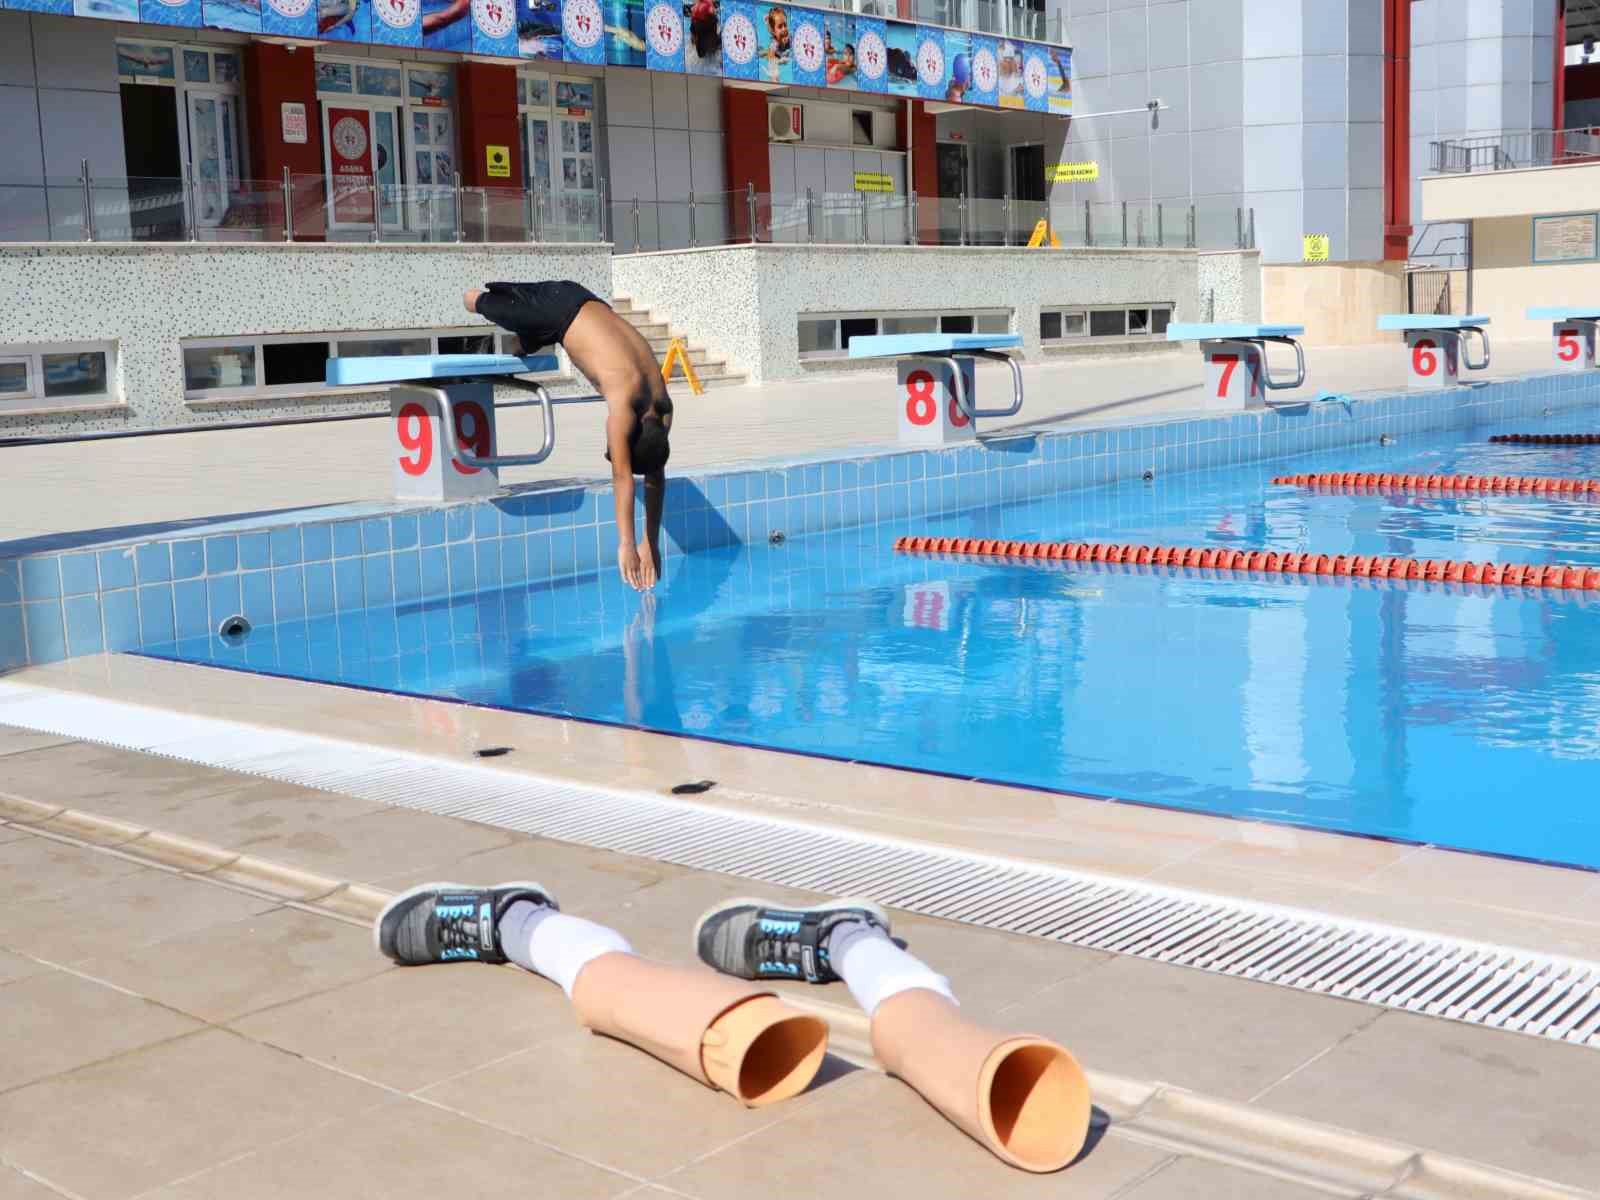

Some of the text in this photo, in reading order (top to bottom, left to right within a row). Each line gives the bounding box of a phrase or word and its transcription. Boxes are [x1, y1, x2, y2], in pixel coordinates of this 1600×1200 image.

[1412, 338, 1437, 376] 6
[1557, 330, 1581, 361] 5
[906, 368, 937, 425] 8
[1211, 353, 1239, 397] 7
[396, 403, 432, 477] 9
[451, 400, 490, 475] 9
